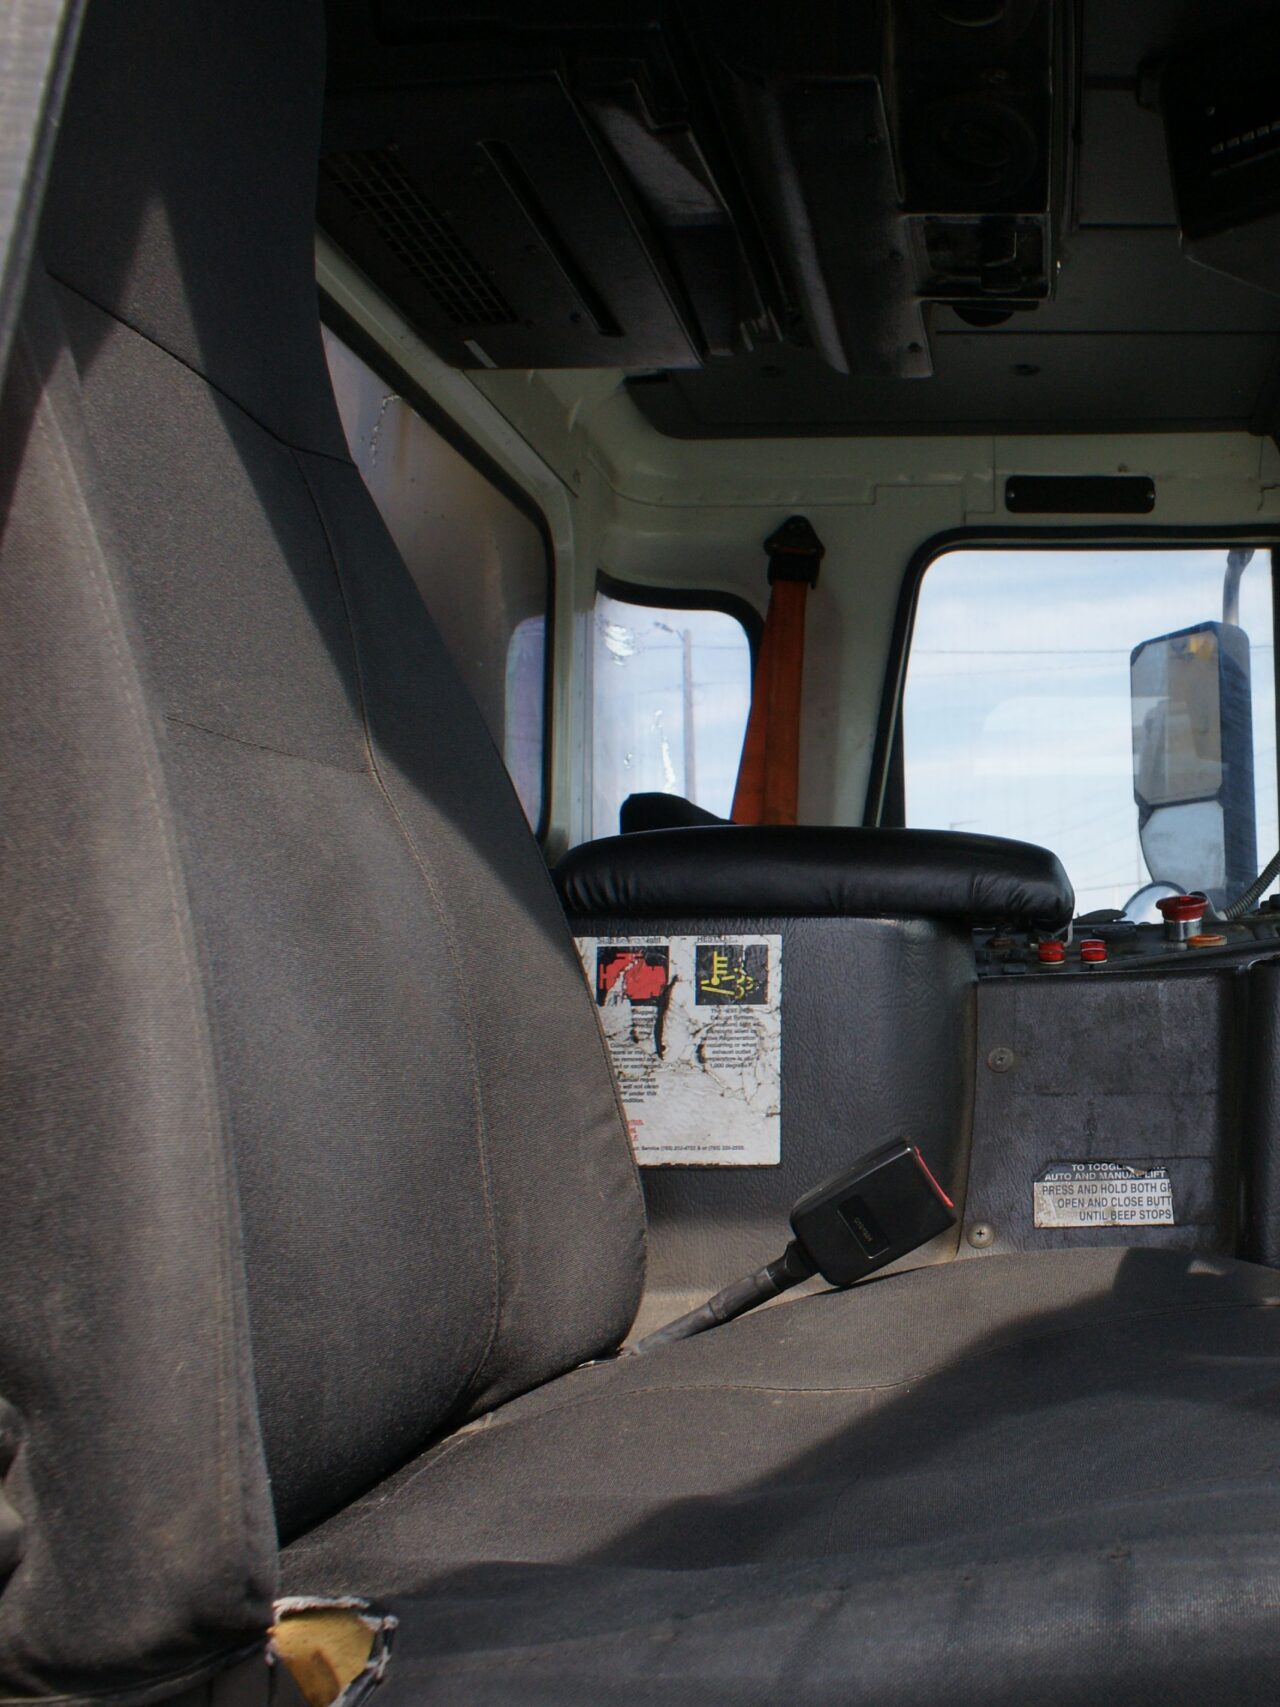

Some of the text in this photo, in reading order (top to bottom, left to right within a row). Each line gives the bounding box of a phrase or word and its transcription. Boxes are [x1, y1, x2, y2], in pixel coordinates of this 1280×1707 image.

[1045, 1170, 1166, 1181] AUTO AND MANUA LIFT
[1042, 1185, 1074, 1196] PRESS
[1078, 1184, 1098, 1195] AND
[1101, 1183, 1128, 1194] HOLD
[1130, 1182, 1157, 1194] BOTH
[1058, 1198, 1085, 1209] OPEN
[1088, 1197, 1108, 1208] AND
[1111, 1196, 1144, 1207] CLOSE
[1079, 1209, 1172, 1221] UNTIL BEEP STOPS
